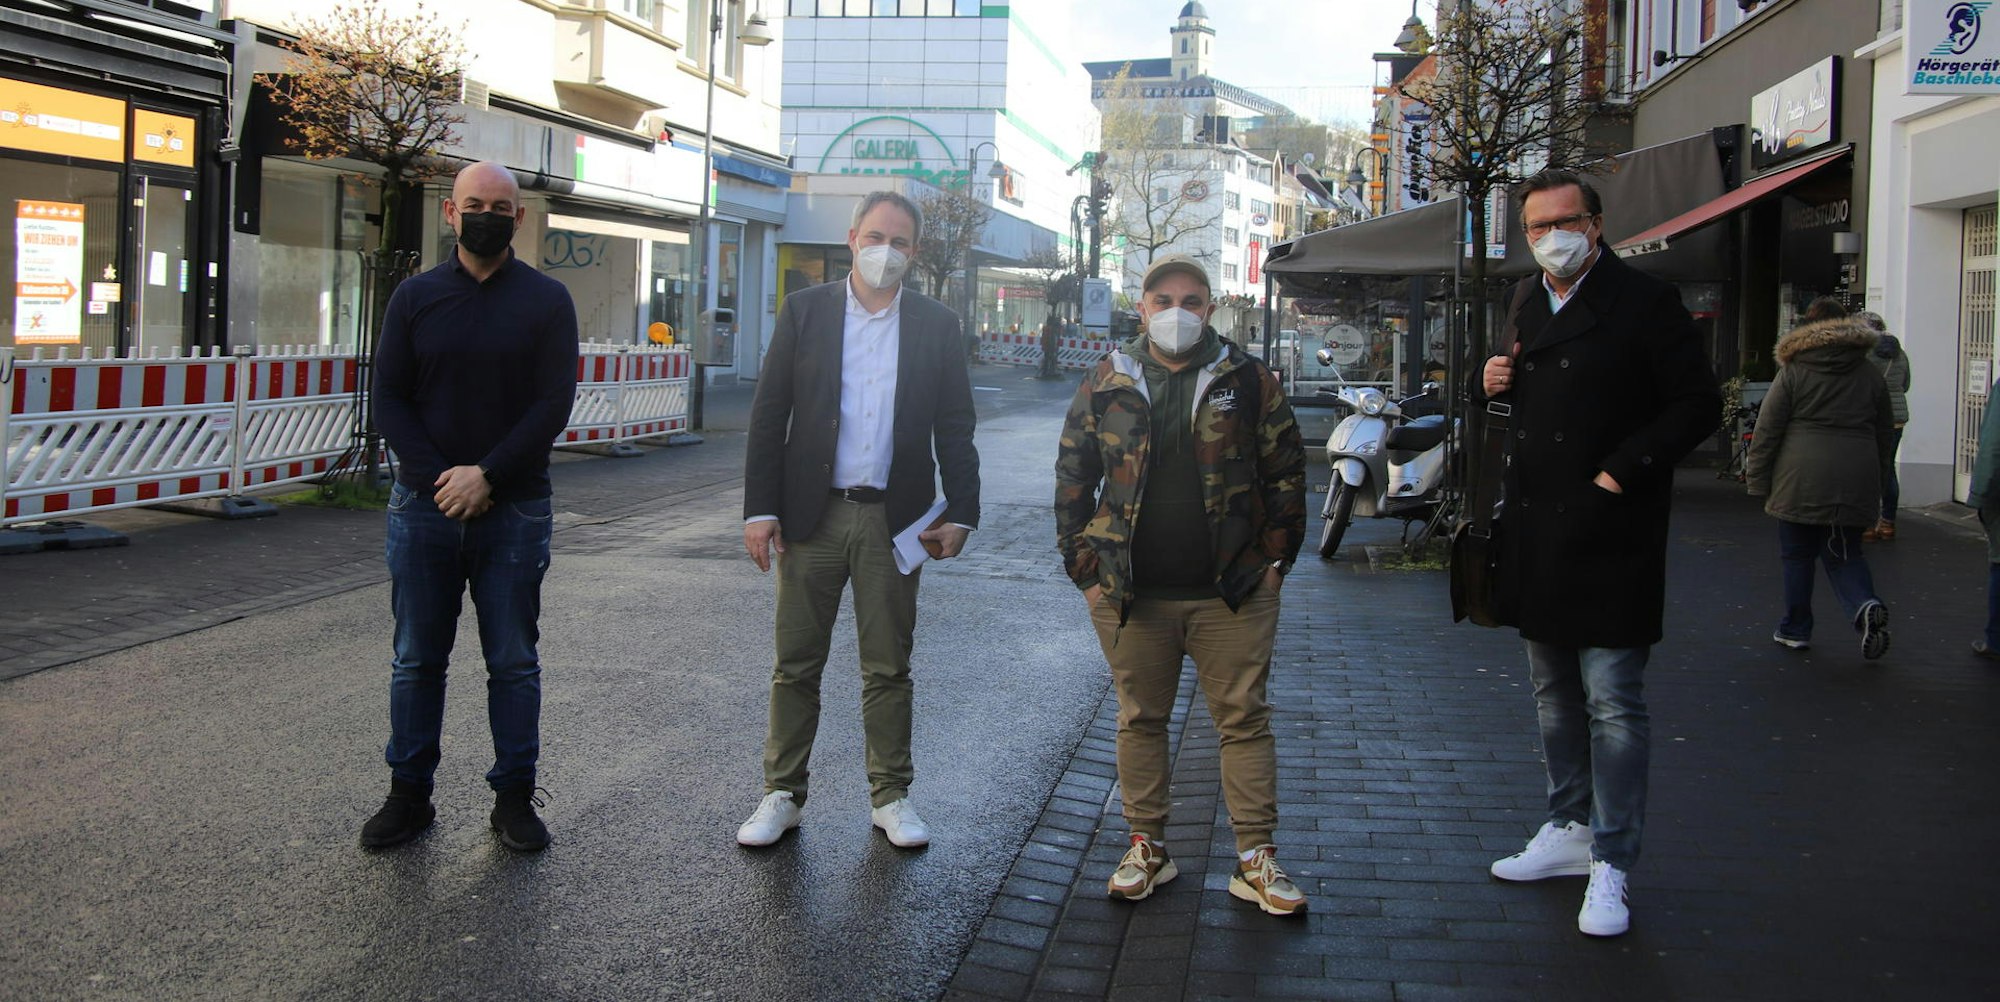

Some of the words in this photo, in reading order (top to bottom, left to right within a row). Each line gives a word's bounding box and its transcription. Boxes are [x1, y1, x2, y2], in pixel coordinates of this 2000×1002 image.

[854, 139, 919, 159] GALERIA
[24, 232, 39, 245] WIR
[40, 233, 65, 247] ZIEHEN
